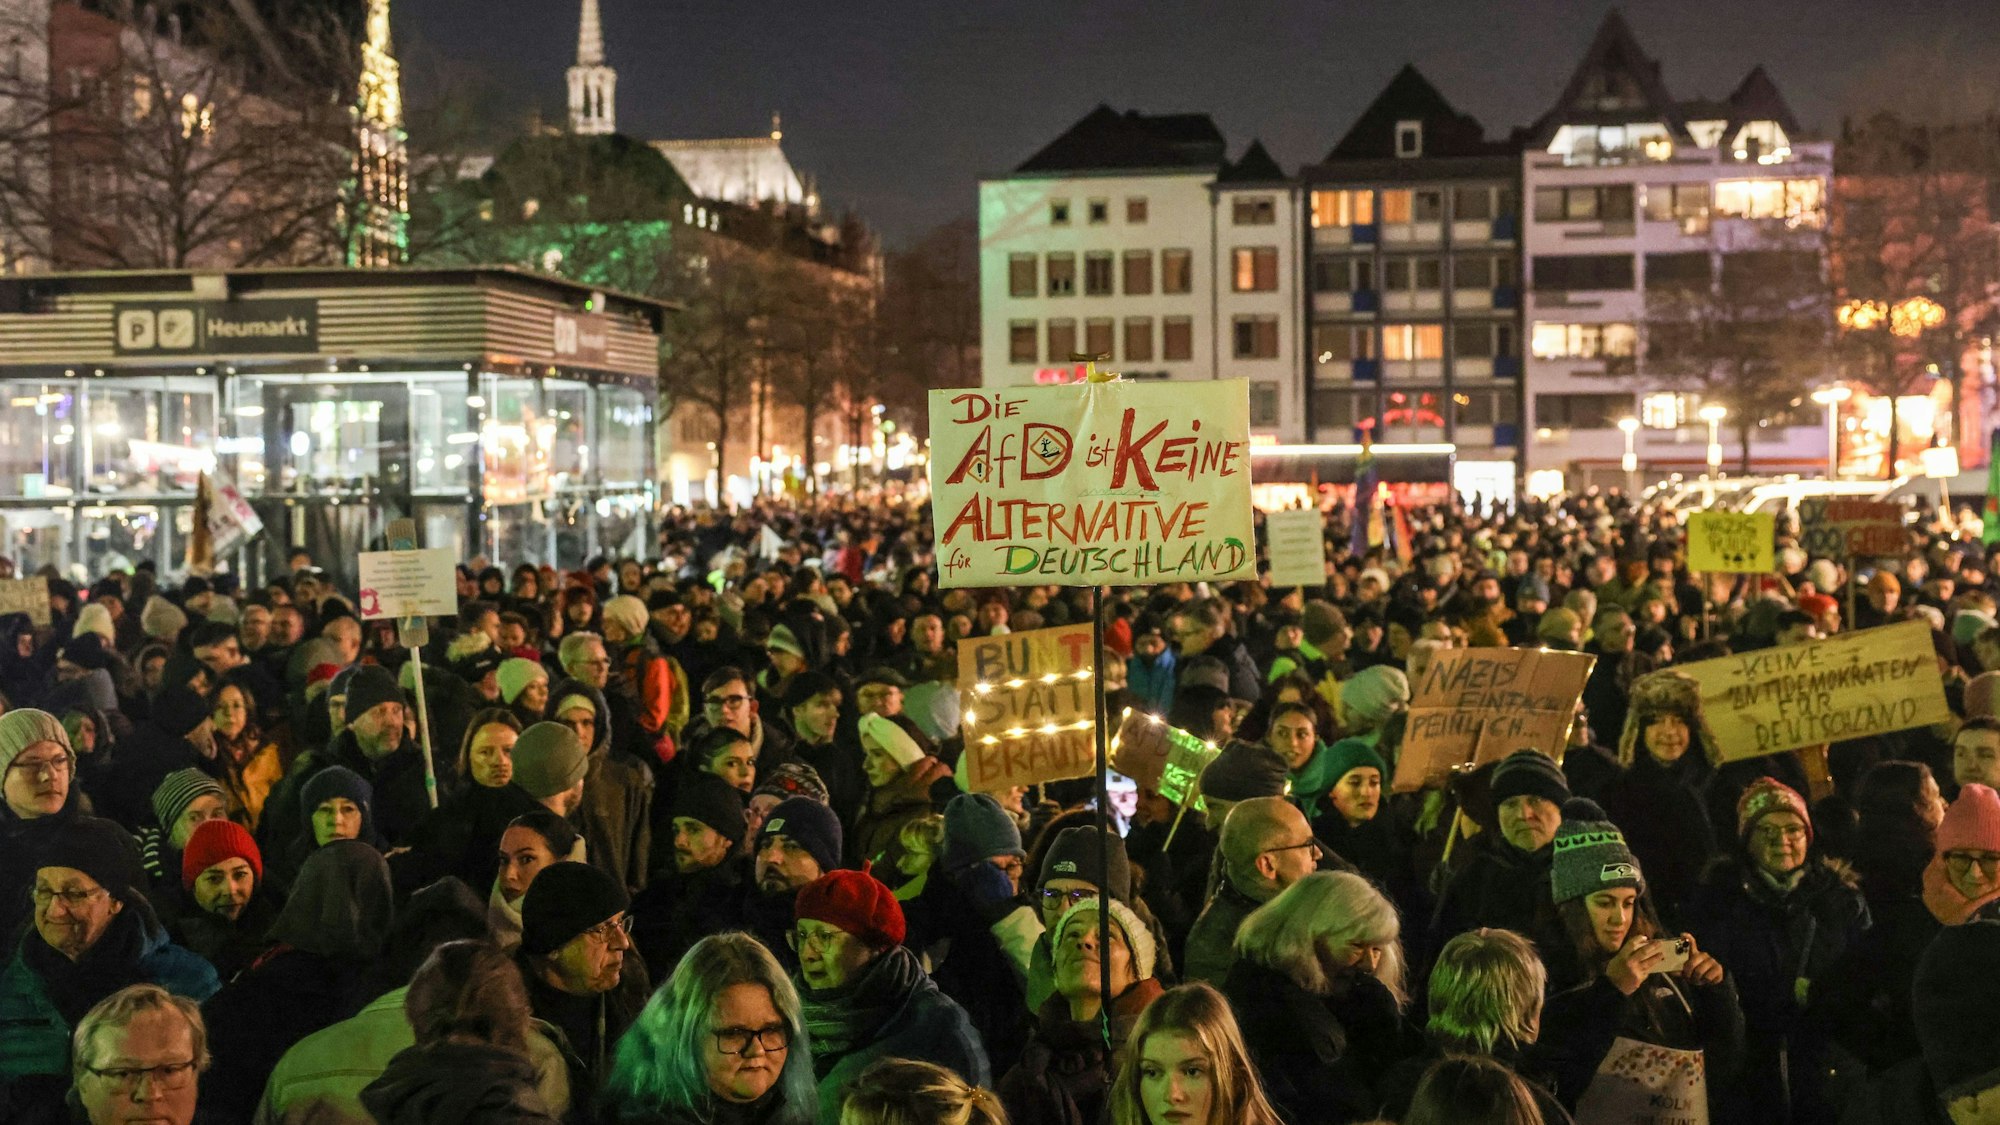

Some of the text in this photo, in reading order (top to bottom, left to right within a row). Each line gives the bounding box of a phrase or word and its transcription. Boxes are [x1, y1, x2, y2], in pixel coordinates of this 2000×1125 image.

[207, 313, 309, 337] Heumarkt
[945, 422, 1074, 489] AfD
[1086, 434, 1115, 467] ist
[994, 537, 1246, 578] DEUTSCHLAND
[975, 633, 1091, 680] BUNT
[1423, 657, 1518, 696] NAZIS
[978, 679, 1083, 724] STATT
[977, 734, 1094, 783] BRAUN
